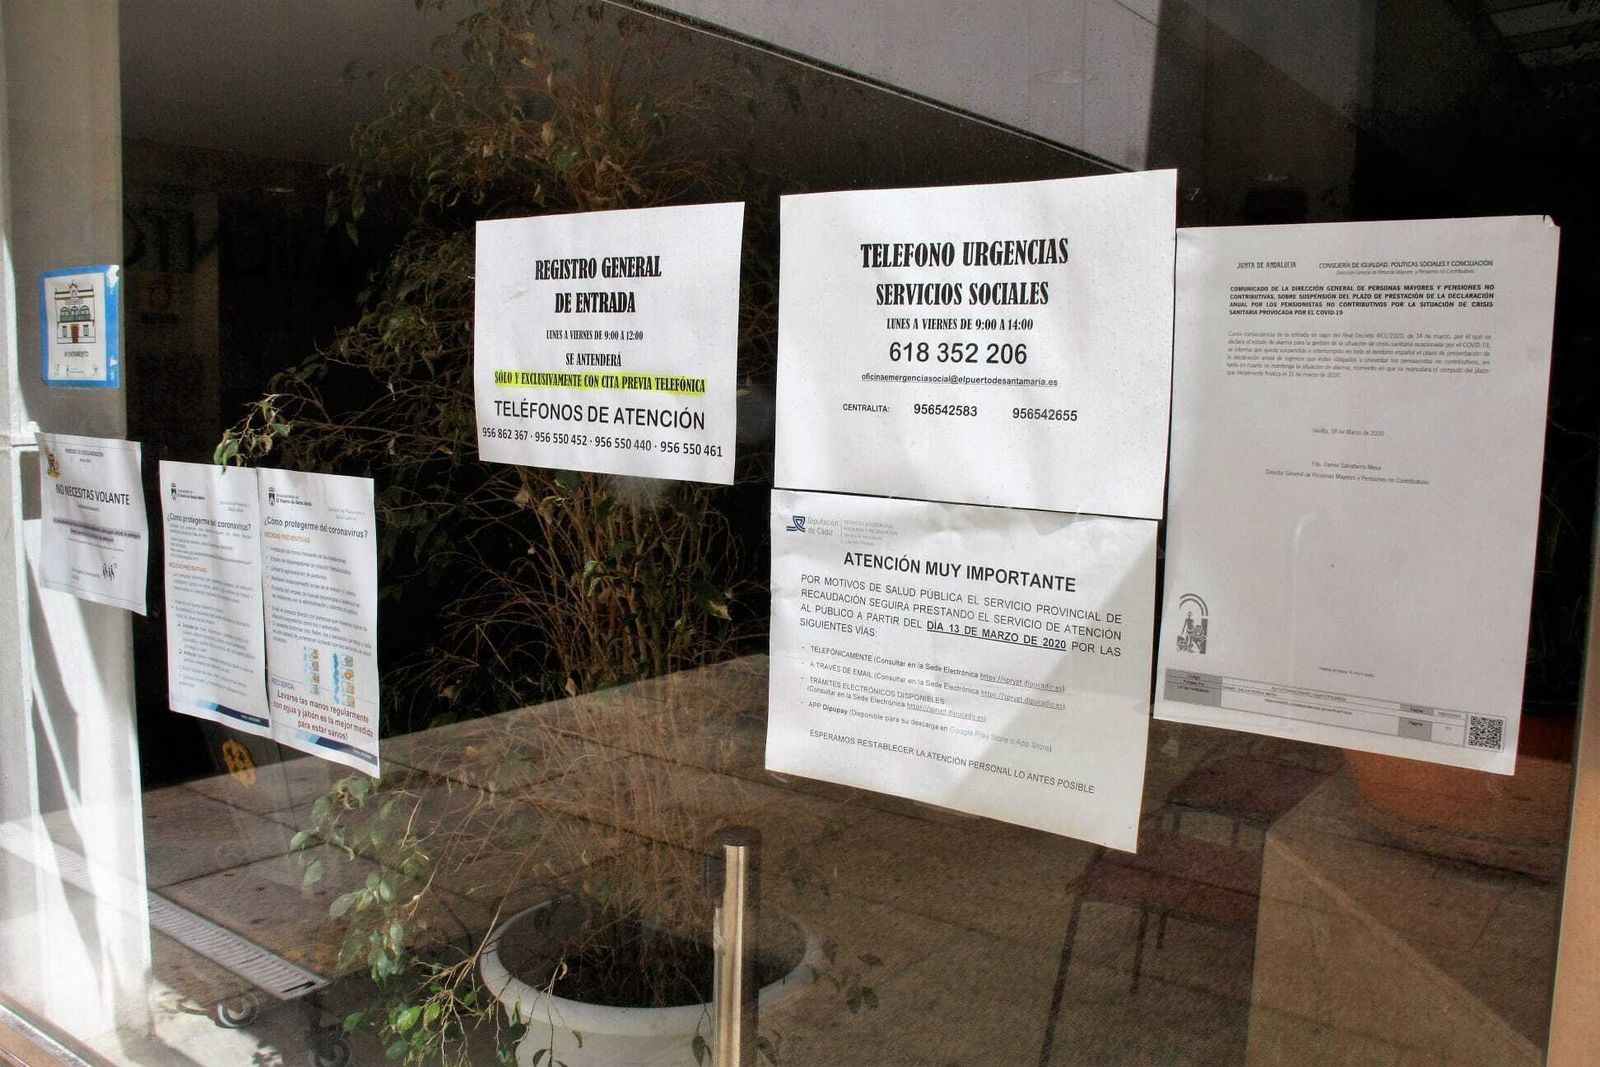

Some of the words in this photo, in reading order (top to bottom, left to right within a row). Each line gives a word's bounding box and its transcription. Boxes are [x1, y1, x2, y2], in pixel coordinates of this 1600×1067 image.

[860, 243, 955, 267] TELEFONO
[962, 238, 1068, 265] URGENCIAS
[535, 258, 597, 279] REGISTRO
[601, 256, 661, 277] GENERAL
[554, 293, 571, 313] DE
[575, 292, 635, 312] ENTRADA
[876, 283, 962, 305] SERVICIOS
[968, 282, 1048, 305] SOCIALES
[546, 330, 562, 339] LUNES
[564, 330, 568, 339] A
[569, 330, 592, 339] VIERNES
[594, 330, 602, 339] DE
[604, 330, 618, 340] 9:00
[620, 330, 624, 340] A
[626, 330, 643, 340] 12:00
[886, 318, 910, 329] LUNES
[913, 318, 918, 329] A
[922, 318, 957, 329] VIERNES
[960, 318, 972, 329] DE
[975, 319, 996, 329] 9:00
[999, 318, 1004, 330] A
[1008, 318, 1033, 330] 14:00
[565, 353, 574, 365] SE
[889, 342, 929, 361] 618
[937, 342, 978, 362] 352
[986, 343, 1027, 364] 206
[515, 372, 519, 384] Y
[521, 372, 581, 386] EXCLUSIVAMENTE
[584, 374, 598, 387] CON
[601, 375, 619, 388] CITA
[621, 376, 651, 389] PREVIA
[654, 377, 704, 392] TELEFÓNICA
[861, 373, 1057, 386] oficinaemergenciasocial@elpuertodesantamaria.es
[494, 399, 582, 420] TELÉFONOS
[587, 405, 609, 423] DE
[613, 408, 704, 429] ATENCIÓN
[843, 403, 889, 412] CENTRALITA:
[914, 404, 977, 416] 956542583
[1012, 408, 1077, 421] 956542655
[482, 427, 496, 437] 956
[497, 428, 512, 439] 862
[514, 429, 528, 440] 367
[534, 431, 550, 442] 956
[552, 433, 568, 444] 550
[570, 434, 587, 445] 452
[594, 436, 612, 447] 956
[614, 437, 631, 449] 550
[633, 439, 651, 450] 440
[660, 441, 679, 453] 956
[682, 443, 701, 455] 550
[703, 445, 722, 457] 461
[56, 484, 64, 499] NO
[65, 486, 94, 505] NECESITAS
[96, 491, 129, 505] VOLANTE
[844, 552, 920, 572] ATENCIÓN
[925, 561, 961, 577] MUY
[966, 566, 1075, 591] IMPORTANTE
[801, 574, 820, 584] POR
[824, 577, 865, 590] MOTIVOS
[869, 582, 881, 592] DE
[885, 585, 915, 596] SALUD
[919, 588, 962, 602] PÚBLICA
[967, 594, 979, 605] EL
[983, 597, 1032, 611] SERVICIO
[1035, 604, 1101, 621] PROVINCIAL
[1106, 613, 1122, 623] DE
[801, 589, 865, 604] RECAUDACIÓN
[913, 604, 976, 619] PRESTANDO
[978, 612, 989, 622] EL
[993, 614, 1042, 629] SERVICIO
[1045, 621, 1060, 632] DE
[1063, 625, 1121, 639] ATENCIÓN
[799, 618, 853, 633] SIGUIENTES
[800, 603, 811, 612] AL
[856, 611, 862, 619] A
[866, 612, 899, 625] PARTIR
[904, 617, 922, 628] DEL
[926, 620, 943, 633] DÍA
[949, 624, 961, 635] 13
[964, 625, 976, 638] DE
[982, 629, 1018, 644] MARZO
[1023, 634, 1037, 647] DE
[1042, 637, 1066, 651] 2020
[1071, 641, 1094, 652] POR
[1100, 645, 1120, 656] LAS
[810, 729, 855, 744] ESPERAMOS
[857, 739, 914, 754] RESTABLECER
[916, 747, 925, 757] LA
[927, 752, 966, 765] ATENCIÓN
[968, 760, 1011, 776] PERSONAL
[1014, 769, 1025, 778] LO
[1026, 773, 1055, 785] ANTES
[1057, 778, 1094, 793] POSIBLE
